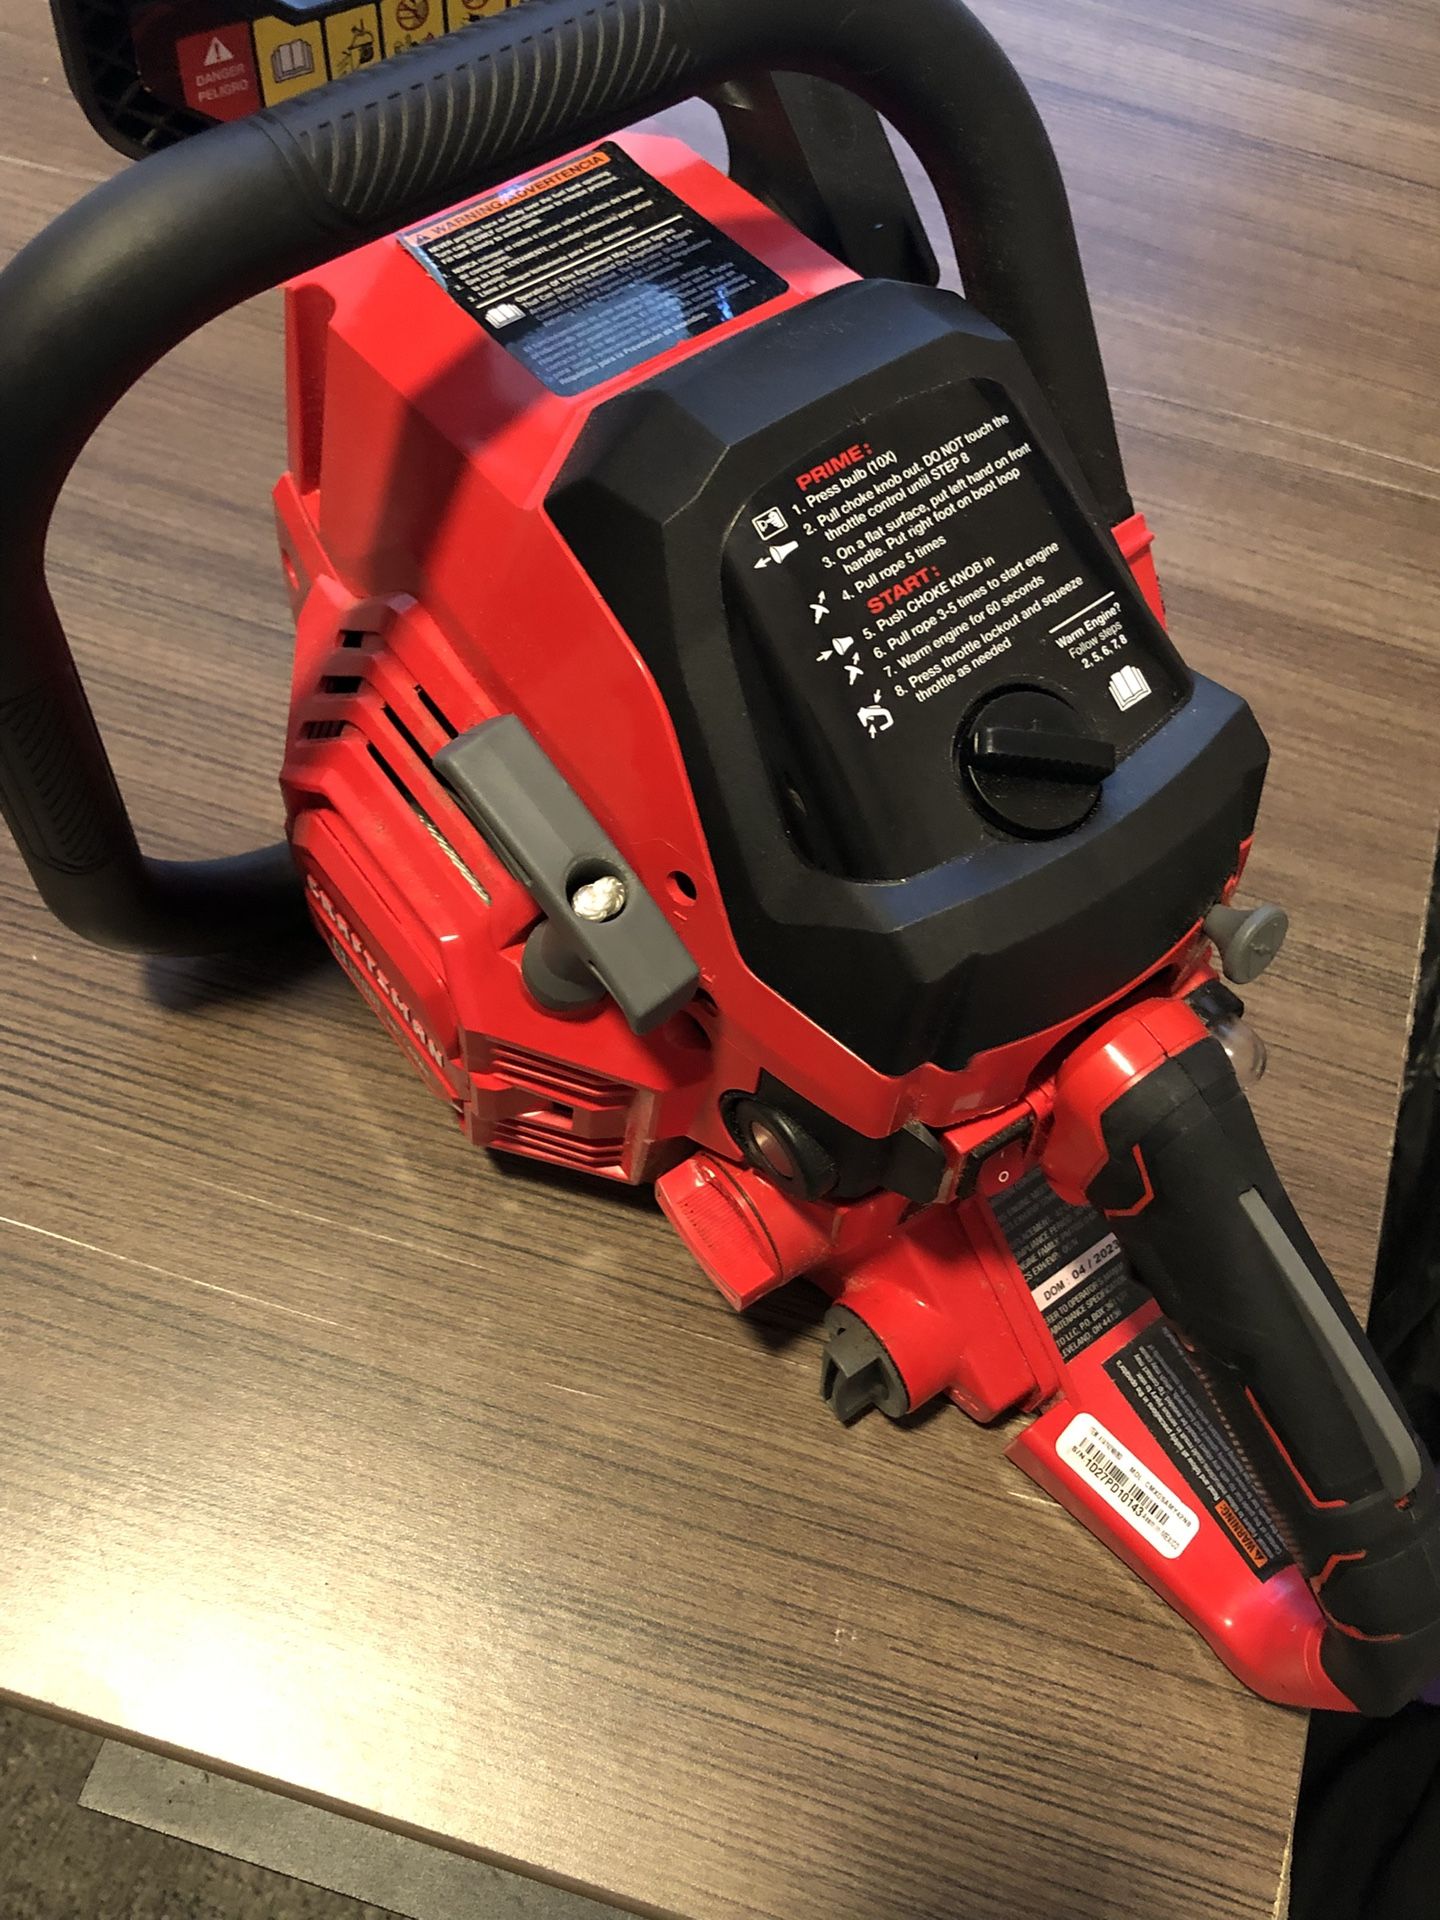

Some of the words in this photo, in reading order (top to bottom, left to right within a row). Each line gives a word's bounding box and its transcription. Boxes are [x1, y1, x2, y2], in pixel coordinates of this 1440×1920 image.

[193, 61, 247, 87] DANGER
[196, 77, 251, 103] PELIGRO
[429, 152, 605, 238] WARNING/ADVERTENCIA
[792, 504, 806, 515] 1.
[805, 484, 841, 508] Press
[839, 468, 867, 488] bulb
[866, 450, 897, 475] (10X)
[796, 443, 872, 491] PRIME:
[803, 523, 818, 535] 2.
[816, 507, 841, 527] Pull
[841, 490, 875, 514] choke
[872, 474, 902, 495] knob
[902, 462, 924, 479] out.
[922, 450, 941, 467] DO
[940, 436, 964, 457] NOT
[964, 422, 994, 444] touch
[992, 415, 1009, 428] the
[821, 556, 836, 568] 3.
[836, 545, 856, 559] On
[856, 539, 866, 549] a
[864, 526, 886, 543] flat
[885, 504, 931, 532] surface,
[929, 489, 950, 509] put
[947, 478, 968, 495] left
[965, 462, 995, 485] hand
[994, 457, 1009, 469] on
[1007, 442, 1031, 461] front
[824, 513, 867, 541] throttle
[867, 487, 907, 517] control
[906, 473, 932, 495] until
[930, 457, 959, 480] STEP
[960, 452, 970, 464] 8
[842, 547, 887, 575] handle.
[885, 531, 908, 550] Put
[907, 516, 934, 538] right
[932, 503, 957, 522] foot
[956, 495, 972, 509] on
[970, 479, 998, 500] boot
[995, 468, 1020, 486] loop
[842, 590, 855, 600] 4.
[854, 573, 879, 593] Pull
[878, 560, 906, 580] rope
[905, 551, 915, 564] 5
[914, 536, 947, 558] times
[862, 627, 876, 640] 5.
[876, 609, 908, 632] Push
[906, 581, 950, 613] CHOKE
[948, 561, 984, 588] KNOB
[982, 556, 995, 568] in
[867, 566, 940, 614] START:
[873, 647, 887, 659] 6.
[887, 630, 911, 650] Pull
[911, 616, 938, 637] rope
[936, 601, 958, 620] 3-5
[956, 586, 988, 608] times
[986, 578, 1000, 590] to
[1000, 561, 1025, 582] start
[1025, 542, 1059, 567] engine
[883, 665, 898, 677] 7.
[896, 645, 932, 668] Warm
[932, 622, 970, 648] engine
[969, 611, 986, 626] for
[985, 600, 1001, 615] 60
[1001, 576, 1045, 607] seconds
[894, 685, 908, 697] 8.
[908, 664, 942, 688] Press
[941, 640, 982, 668] throttle
[979, 614, 1021, 644] lockout
[1020, 600, 1042, 620] and
[1041, 577, 1083, 607] squeeze
[1055, 627, 1085, 648] Warm
[1083, 602, 1121, 631] Engine?
[1068, 636, 1099, 659] Follow
[1098, 621, 1123, 641] steps
[915, 674, 956, 702] throttle
[956, 664, 972, 677] as
[971, 636, 1012, 668] needed
[1081, 658, 1094, 669] 2,
[1091, 651, 1104, 662] 5,
[1101, 645, 1114, 656] 6,
[1042, 1278, 1066, 1302] DOM
[1069, 1262, 1086, 1281] 04
[1085, 1258, 1094, 1269] /
[1091, 1321, 1103, 1335] OH
[1132, 1351, 1146, 1367] may
[1141, 1364, 1160, 1388] contact
[1133, 1385, 1146, 1398] the
[1148, 1388, 1165, 1408] injury
[1145, 1400, 1173, 1435] precautions
[1159, 1405, 1179, 1428] serious
[1178, 1416, 1189, 1426] be
[1184, 1423, 1202, 1445] should
[1167, 1431, 1186, 1451] safety
[1178, 1430, 1195, 1450] result
[1189, 1446, 1206, 1465] could
[1185, 1455, 1203, 1476] follow
[1197, 1472, 1211, 1487] and
[1201, 1461, 1228, 1495] instructions
[1205, 1483, 1221, 1502] Read
[1216, 1502, 1257, 1553] WARNING:
